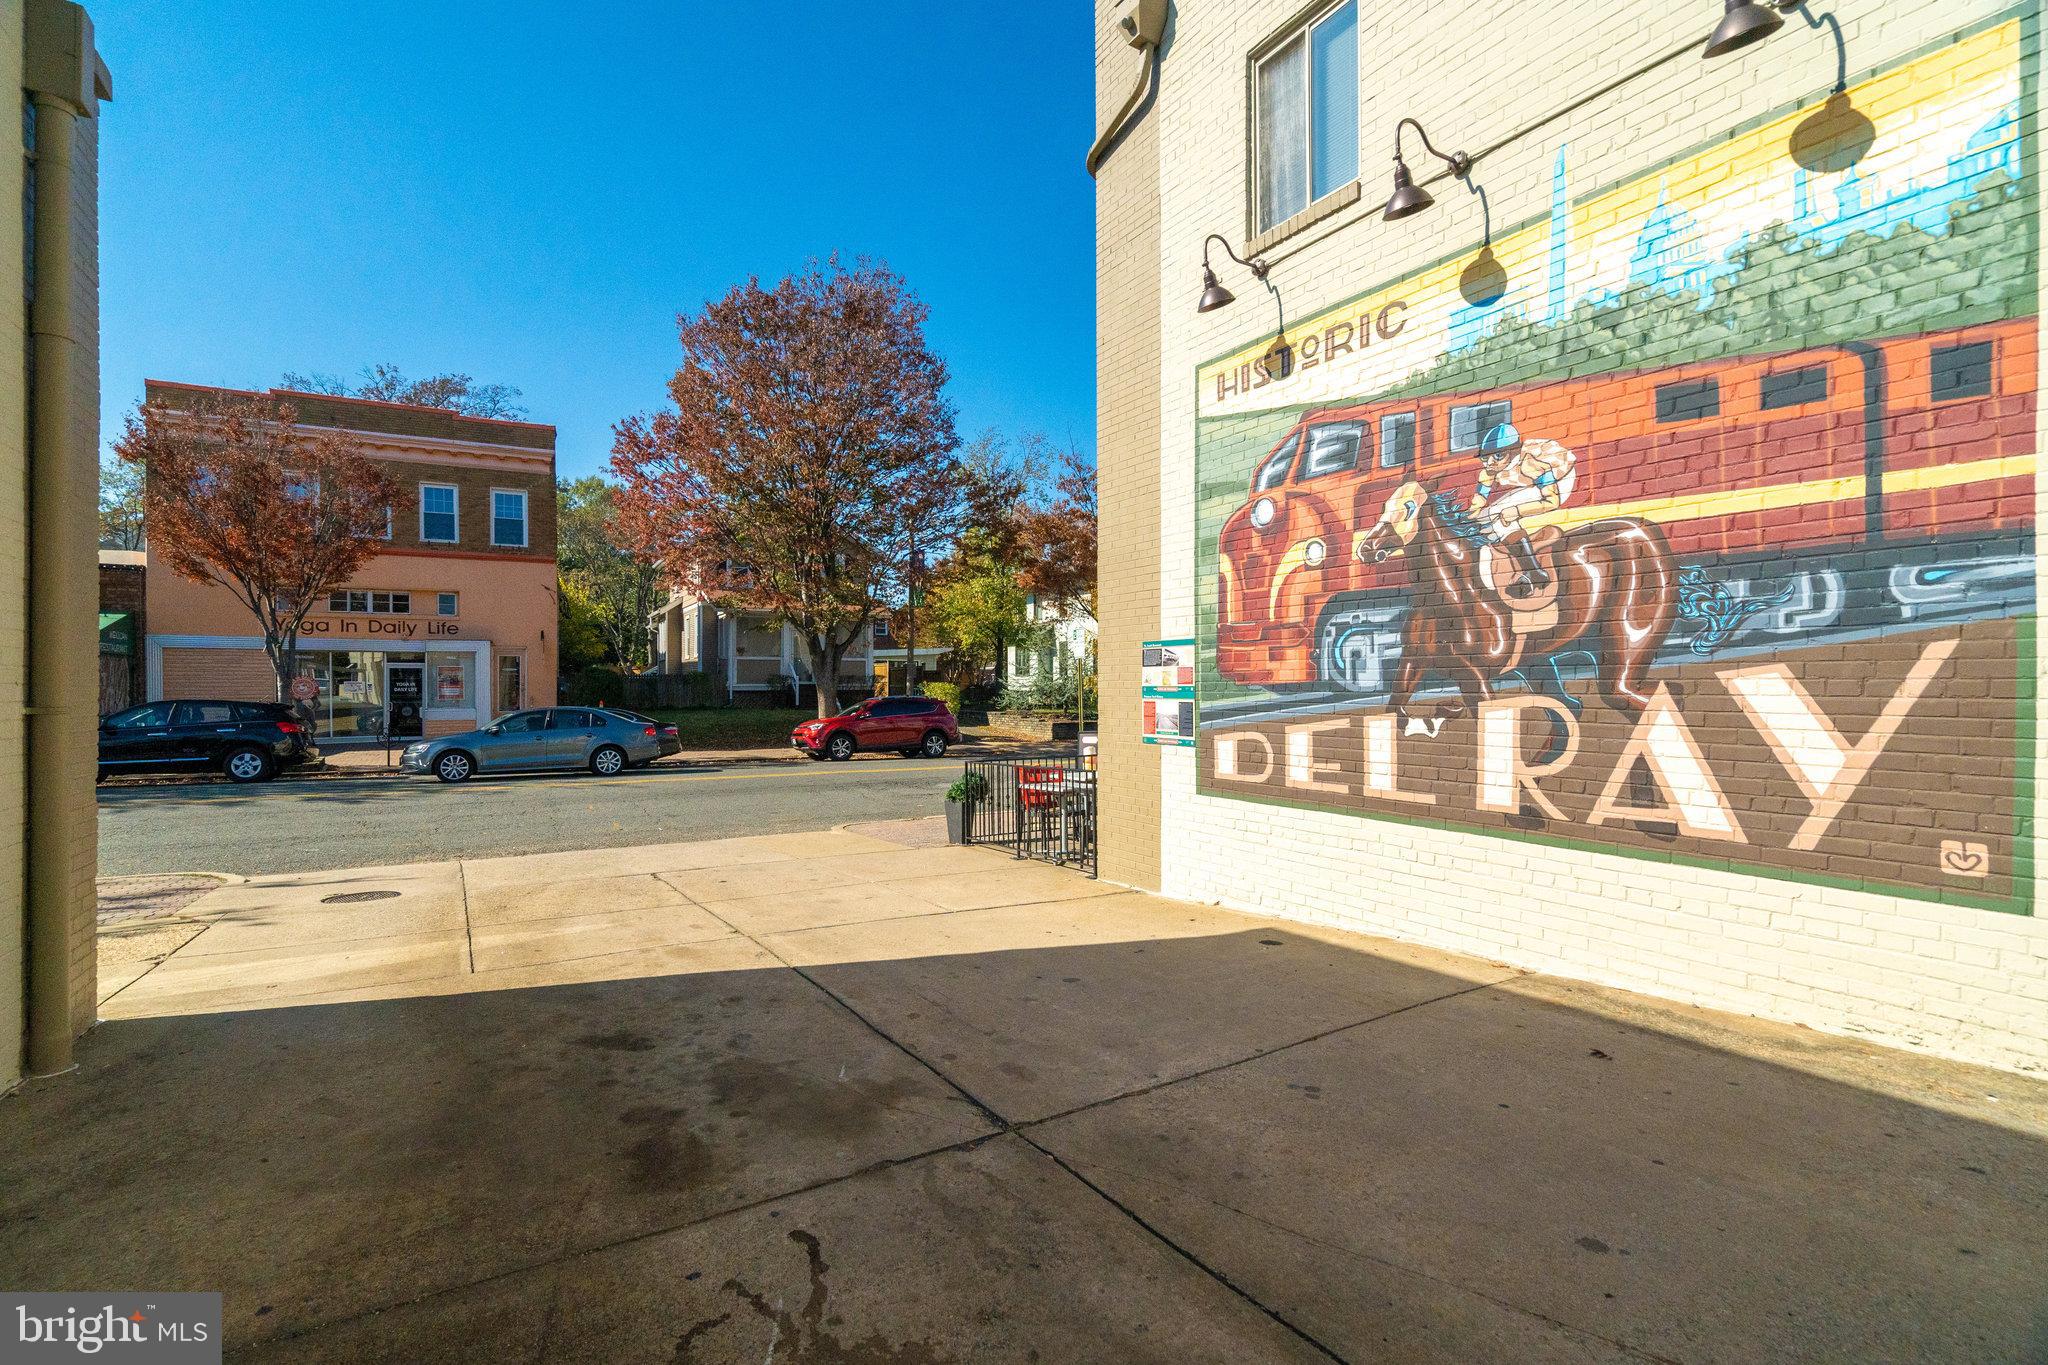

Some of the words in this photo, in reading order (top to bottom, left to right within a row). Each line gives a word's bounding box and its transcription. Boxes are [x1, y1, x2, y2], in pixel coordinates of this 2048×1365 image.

[1217, 300, 1408, 402] HISTORIC
[340, 619, 358, 633] In
[369, 619, 418, 637] Daily
[428, 621, 459, 635] Life
[1213, 712, 1436, 804] DEL
[1476, 638, 1960, 851] RAY
